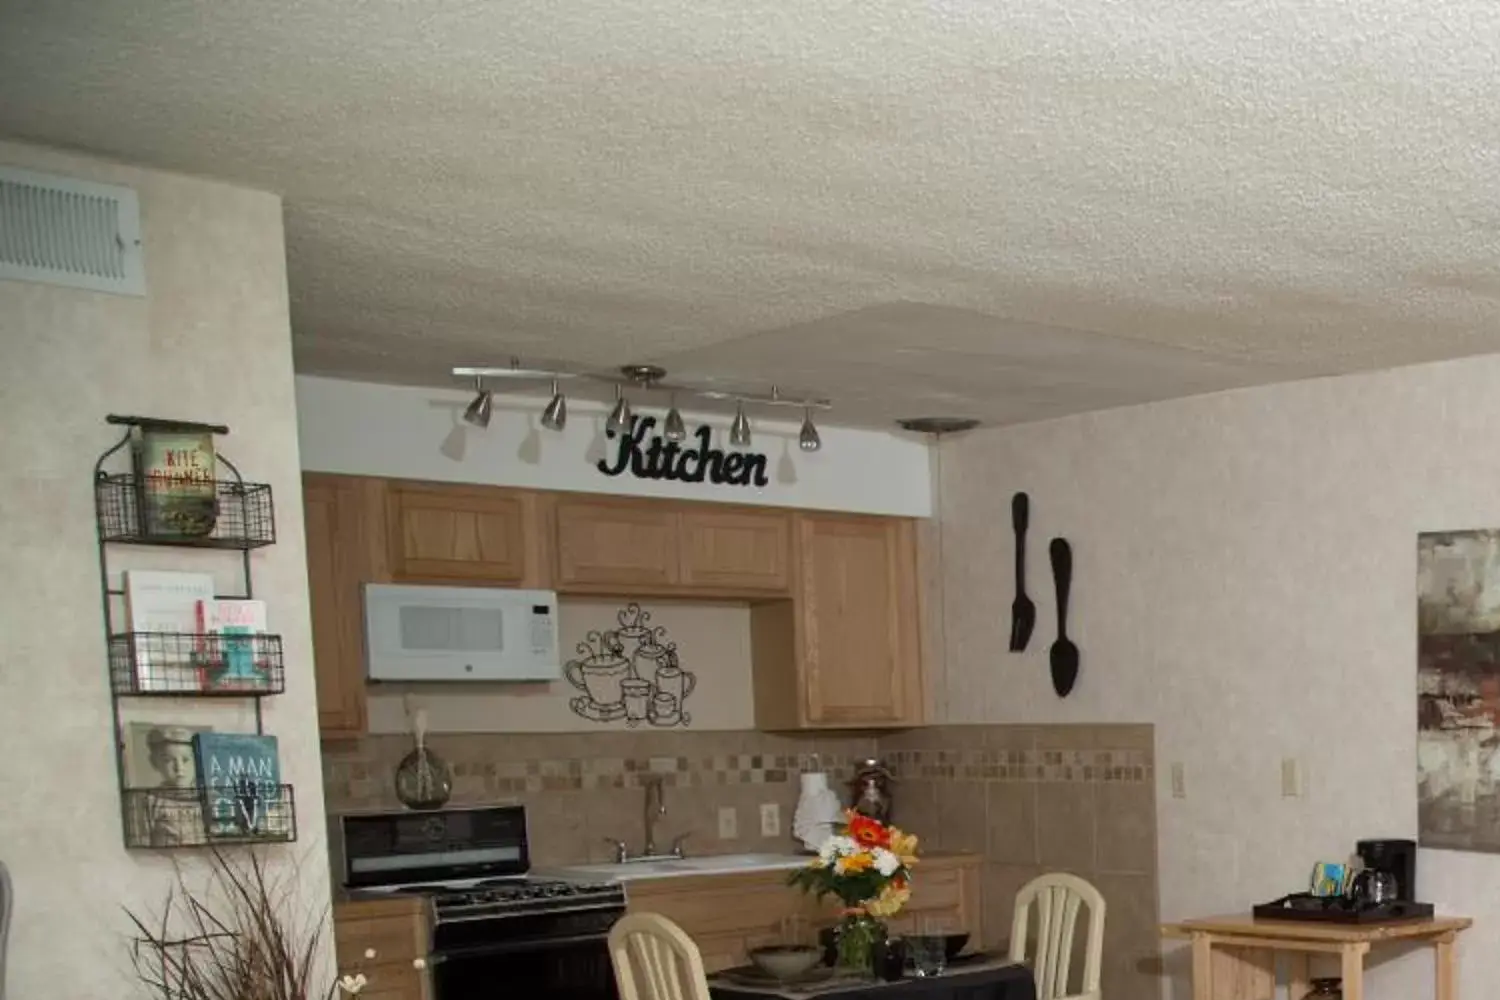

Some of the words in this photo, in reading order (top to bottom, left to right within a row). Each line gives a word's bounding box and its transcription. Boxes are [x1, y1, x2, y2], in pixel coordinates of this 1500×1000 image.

[597, 415, 768, 486] Kitchen
[210, 753, 222, 775] A
[228, 754, 272, 777] MAN
